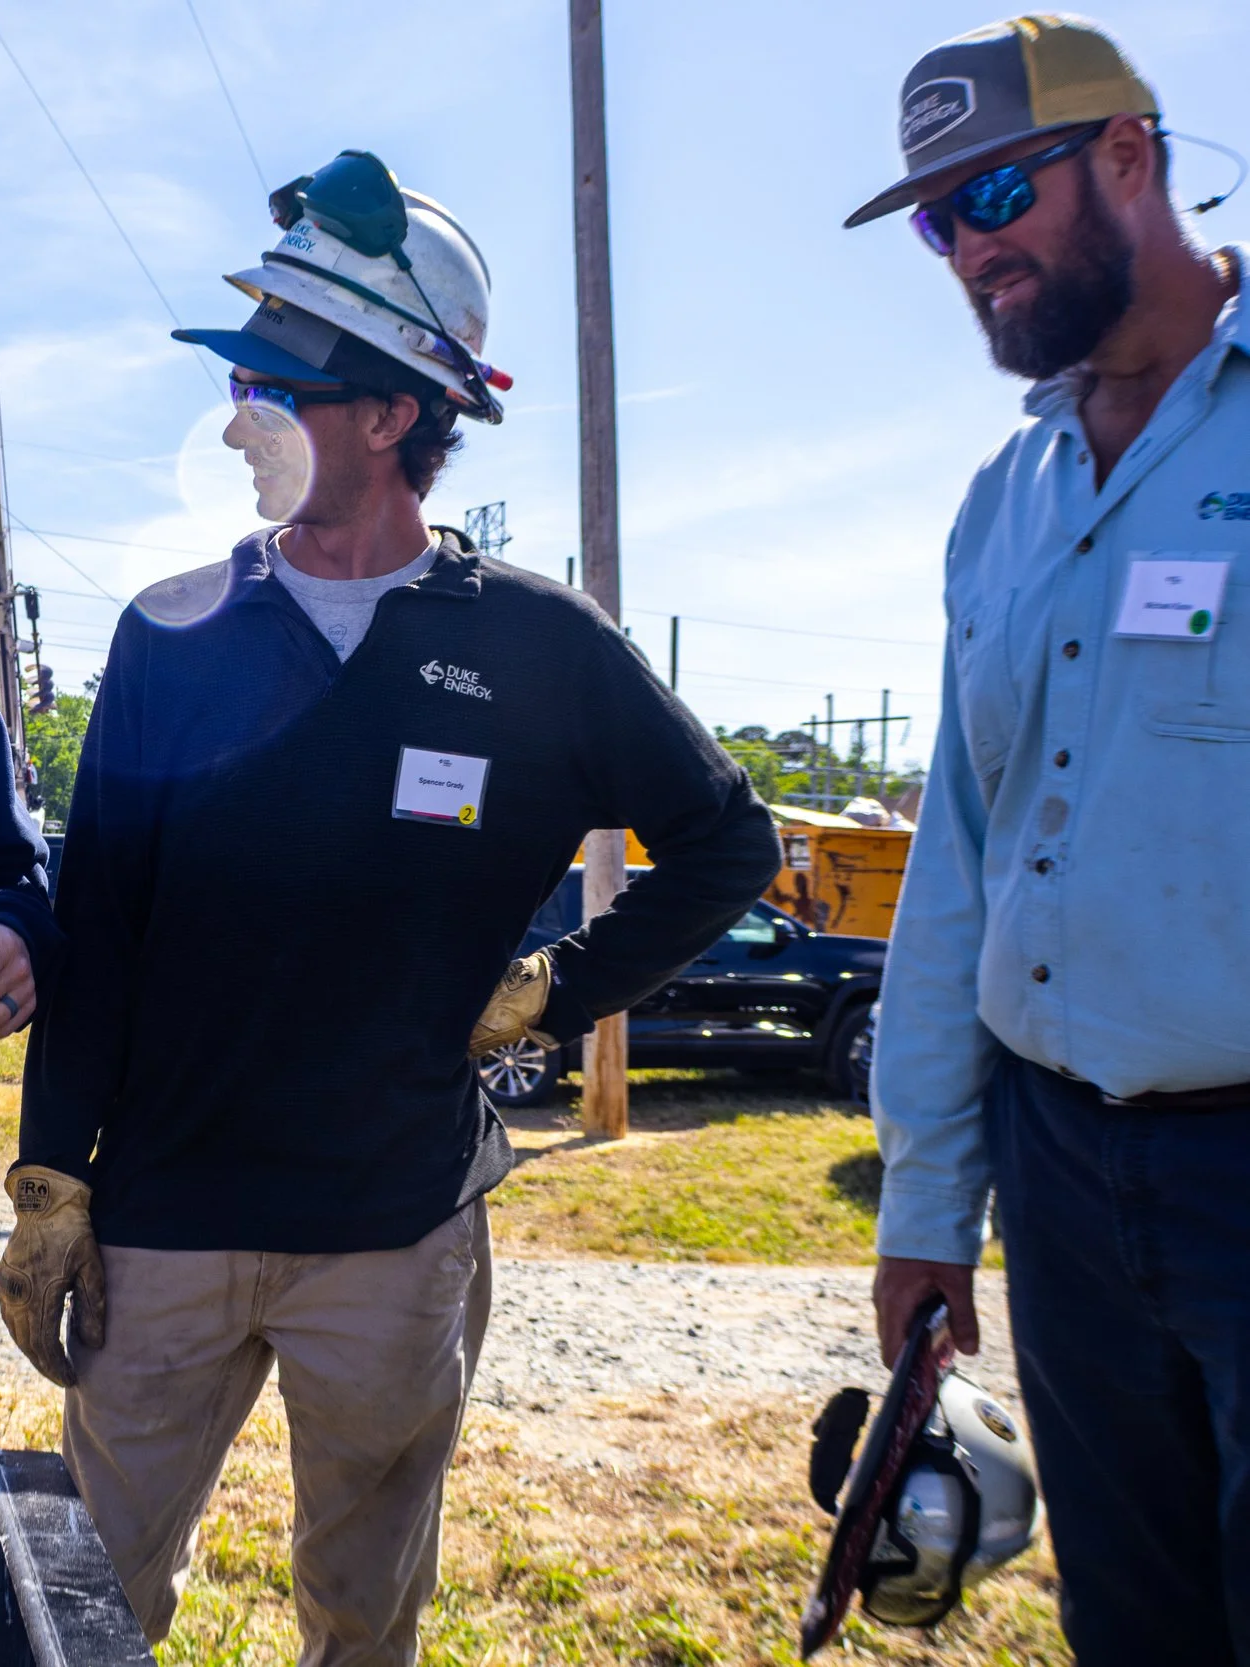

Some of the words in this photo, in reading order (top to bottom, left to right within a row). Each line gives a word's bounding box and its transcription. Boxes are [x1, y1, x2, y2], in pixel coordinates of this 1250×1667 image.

[447, 664, 480, 684] DUKE
[444, 677, 492, 700] ENERGY
[418, 777, 445, 787] Spencer
[446, 780, 464, 790] Grady
[463, 807, 472, 821] 2
